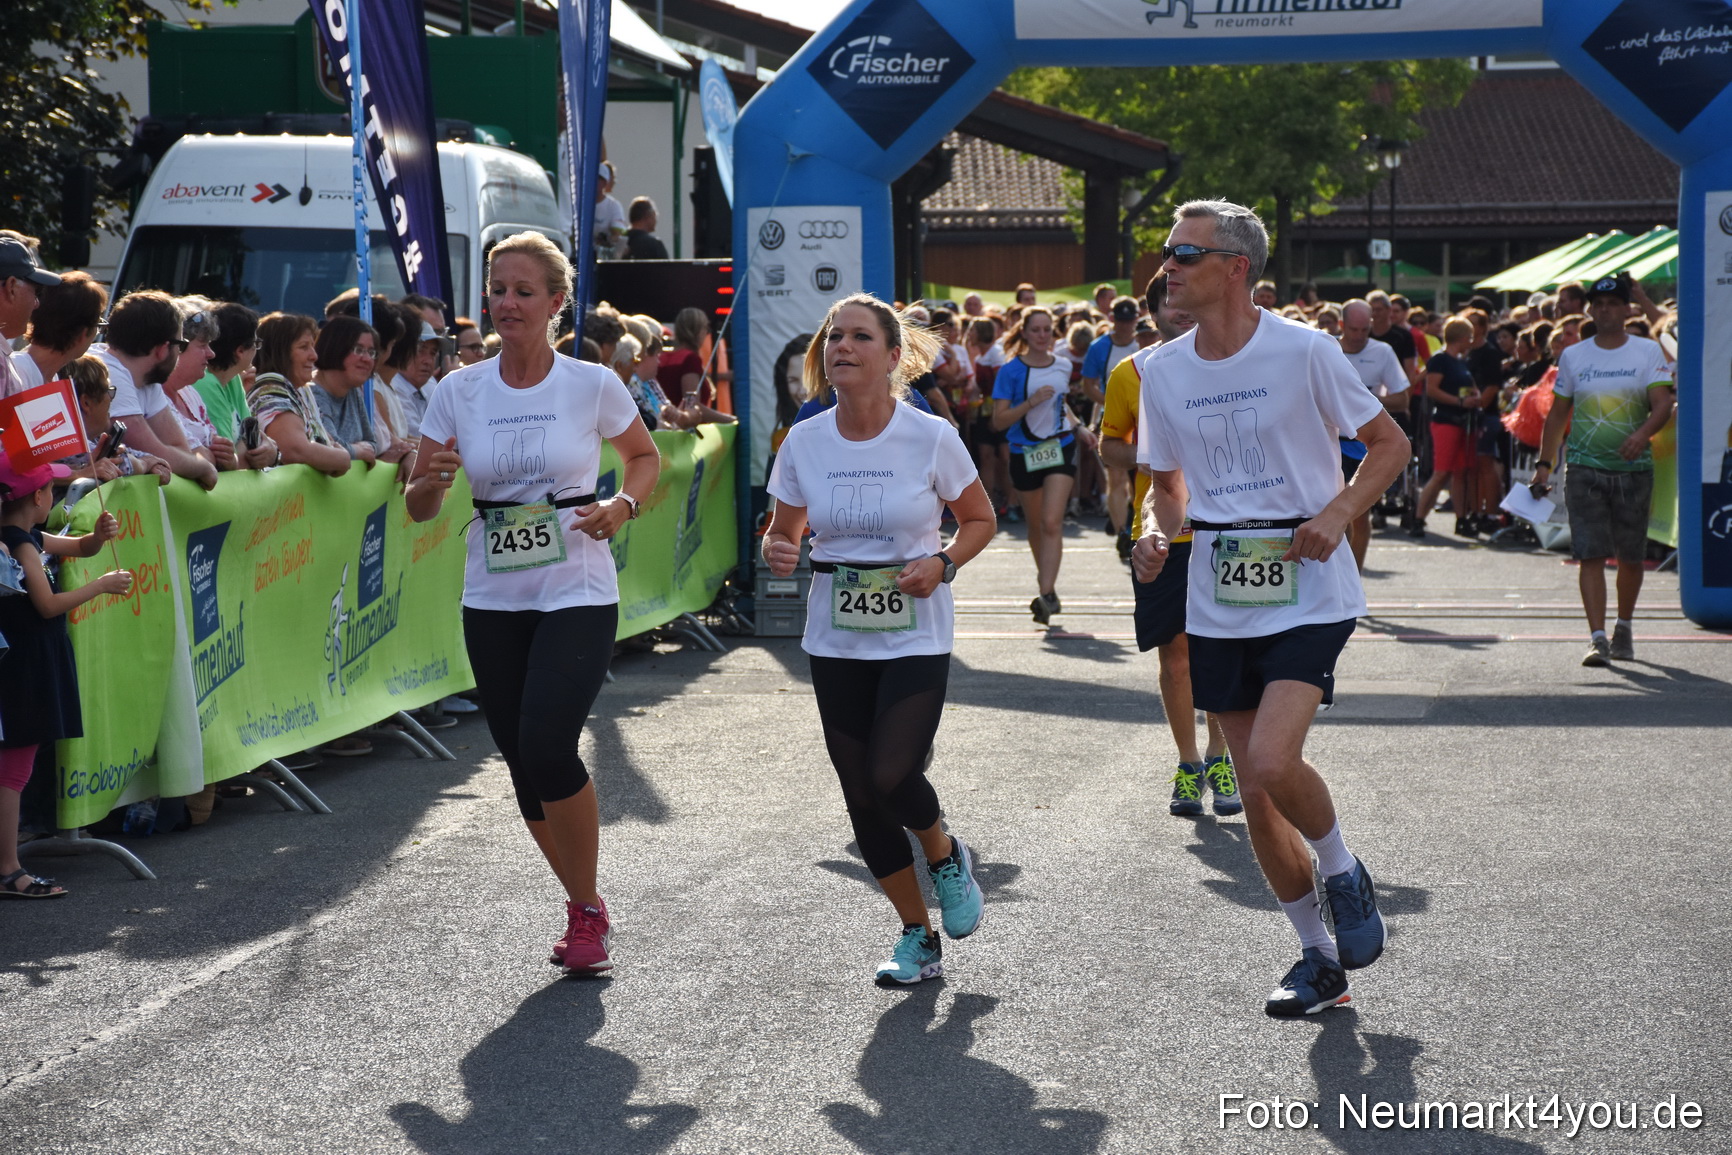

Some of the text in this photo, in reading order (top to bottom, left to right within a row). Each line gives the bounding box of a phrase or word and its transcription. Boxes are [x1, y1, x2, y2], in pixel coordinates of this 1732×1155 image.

[1214, 15, 1294, 28] neumarkt
[1653, 28, 1682, 44] das
[1684, 25, 1732, 40] Lächel
[849, 52, 950, 73] Fischer
[857, 74, 941, 85] AUTOMOBILE
[162, 183, 247, 200] abavent
[800, 243, 822, 251] Audi
[757, 289, 792, 297] SEAT
[1593, 368, 1637, 378] firmenlauf
[1185, 387, 1268, 410] ZAHNARZTPRAXIS
[41, 418, 57, 432] DEHN
[488, 413, 557, 427] ZAHNARZTPRAXIS
[31, 444, 52, 456] DEHN
[1029, 448, 1058, 464] 1036
[508, 478, 534, 487] GÜNTER
[827, 470, 894, 480] ZAHNARZTPRAXIS
[1205, 476, 1285, 498] RALF GÜNTER HELM
[490, 523, 551, 555] 2435
[876, 534, 894, 543] HELM
[192, 558, 215, 584] Fischer
[1220, 560, 1285, 588] 2438
[839, 590, 904, 616] 2436
[345, 570, 404, 662] firmenlauf
[189, 600, 245, 702] irmenlauf
[199, 694, 220, 732] eumarkt
